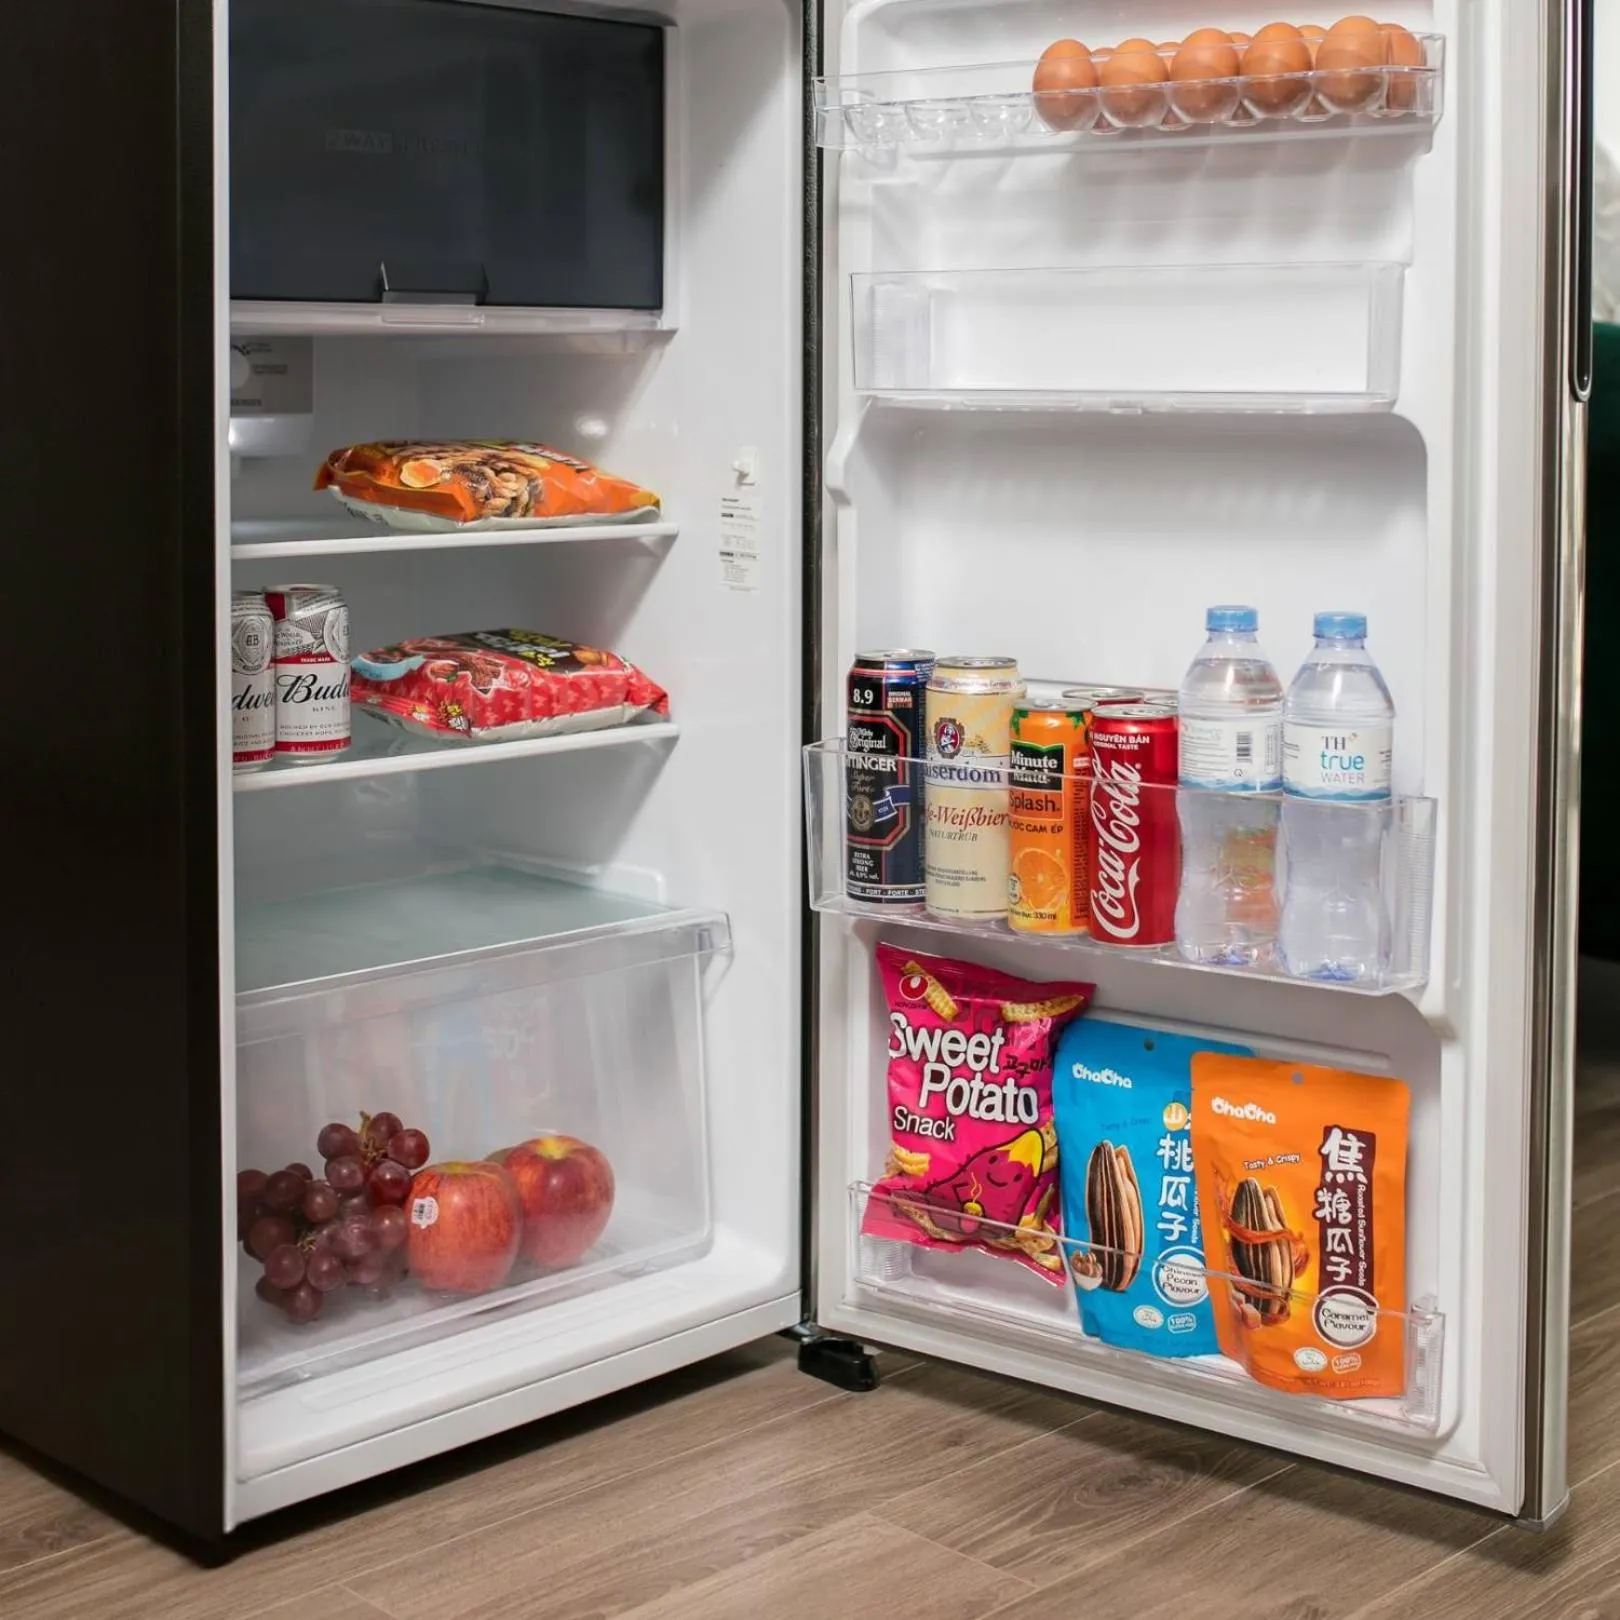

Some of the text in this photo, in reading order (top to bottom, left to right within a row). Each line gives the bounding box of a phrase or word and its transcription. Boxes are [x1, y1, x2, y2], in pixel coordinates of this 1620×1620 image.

[853, 688, 875, 704] 8.9
[1117, 743, 1139, 751] TASTE
[1320, 735, 1346, 751] TH
[1011, 749, 1059, 769] Minute
[1320, 751, 1365, 771] true
[1321, 772, 1365, 785] WATER
[1009, 790, 1056, 813] Splash
[1025, 823, 1048, 834] CAM
[1089, 746, 1142, 939] Coca-Cola
[887, 1010, 1006, 1075] Sweet
[1071, 1062, 1133, 1090] ChaCha
[918, 1063, 1040, 1125] Potato
[1211, 1096, 1277, 1124] ChaCha
[893, 1104, 956, 1142] Snack
[1243, 1153, 1301, 1171] Tasty & Crispy
[1315, 1127, 1369, 1284] 焦糖瓜子
[1356, 1184, 1368, 1287] Roasted Sunflower Seeds
